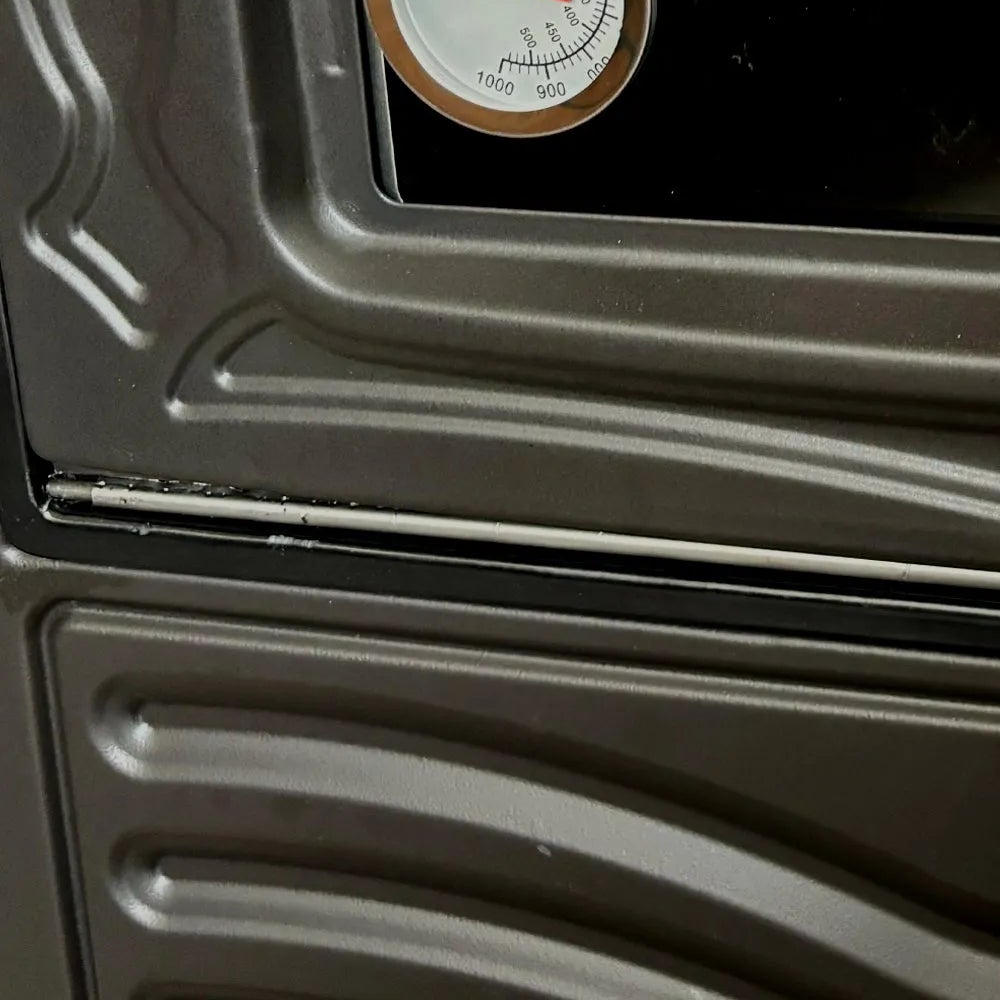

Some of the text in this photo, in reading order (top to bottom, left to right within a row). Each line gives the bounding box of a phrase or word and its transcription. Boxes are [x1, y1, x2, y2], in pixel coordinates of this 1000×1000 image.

[564, 5, 580, 27] 400
[520, 27, 537, 49] 500
[545, 22, 561, 43] 450
[477, 70, 515, 96] 1000
[536, 81, 566, 100] 900
